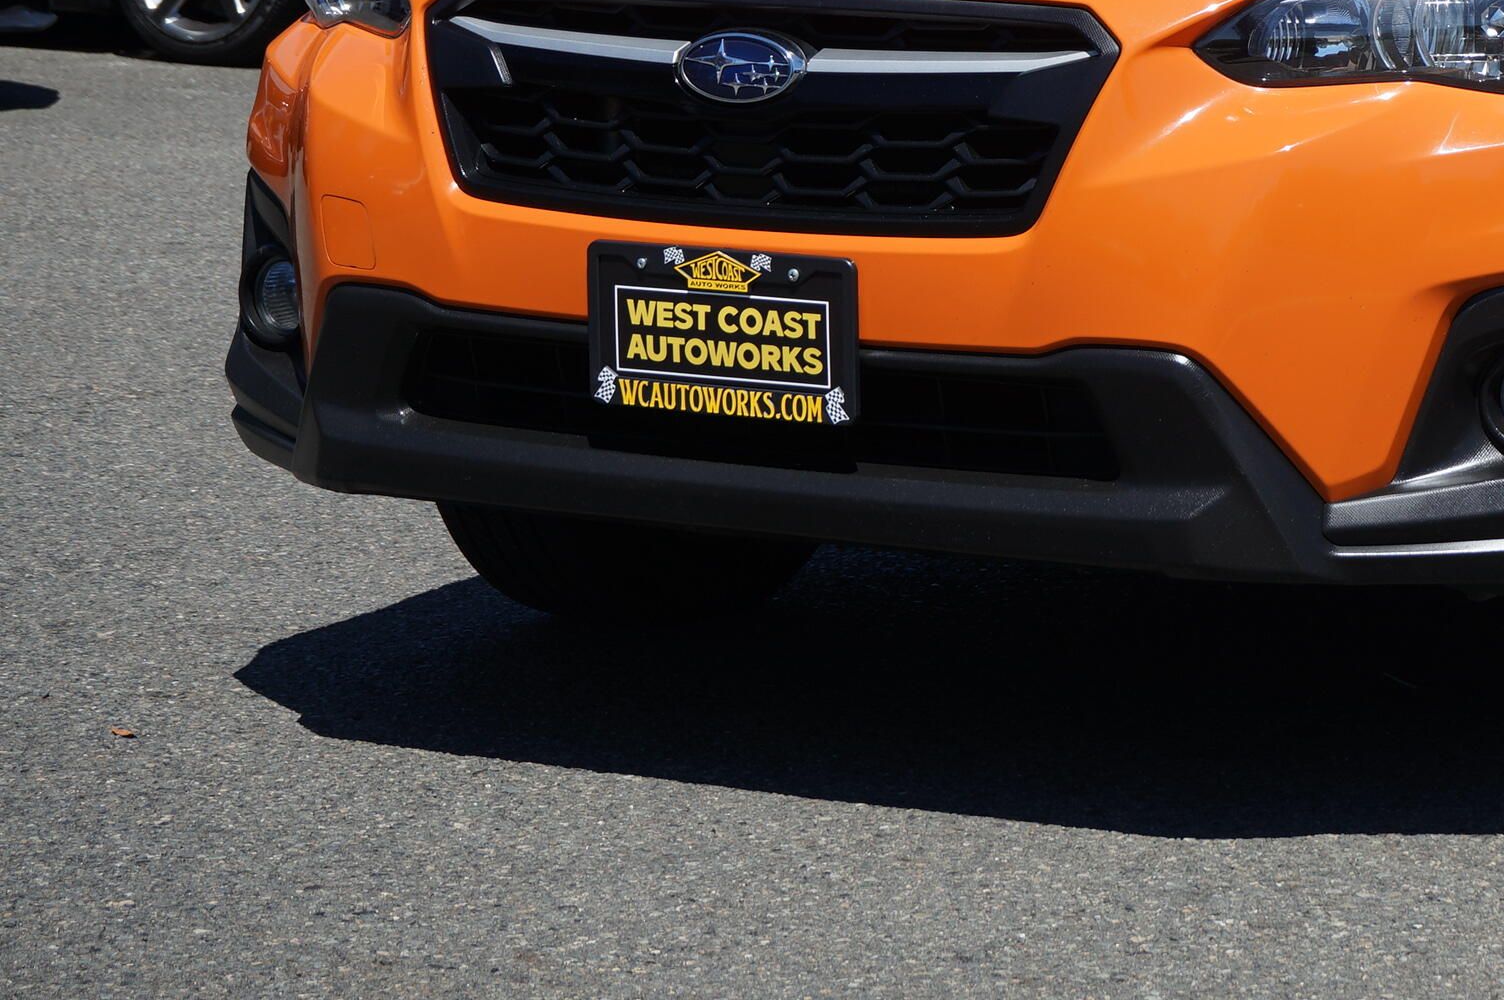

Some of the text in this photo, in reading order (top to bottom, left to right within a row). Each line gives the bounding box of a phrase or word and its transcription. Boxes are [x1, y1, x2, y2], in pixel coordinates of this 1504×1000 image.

[715, 282, 746, 291] WORKS
[626, 298, 821, 340] WEST COAST
[626, 333, 823, 375] AUTOWORKS
[618, 378, 823, 424] WCAUTOWORKS.COM
